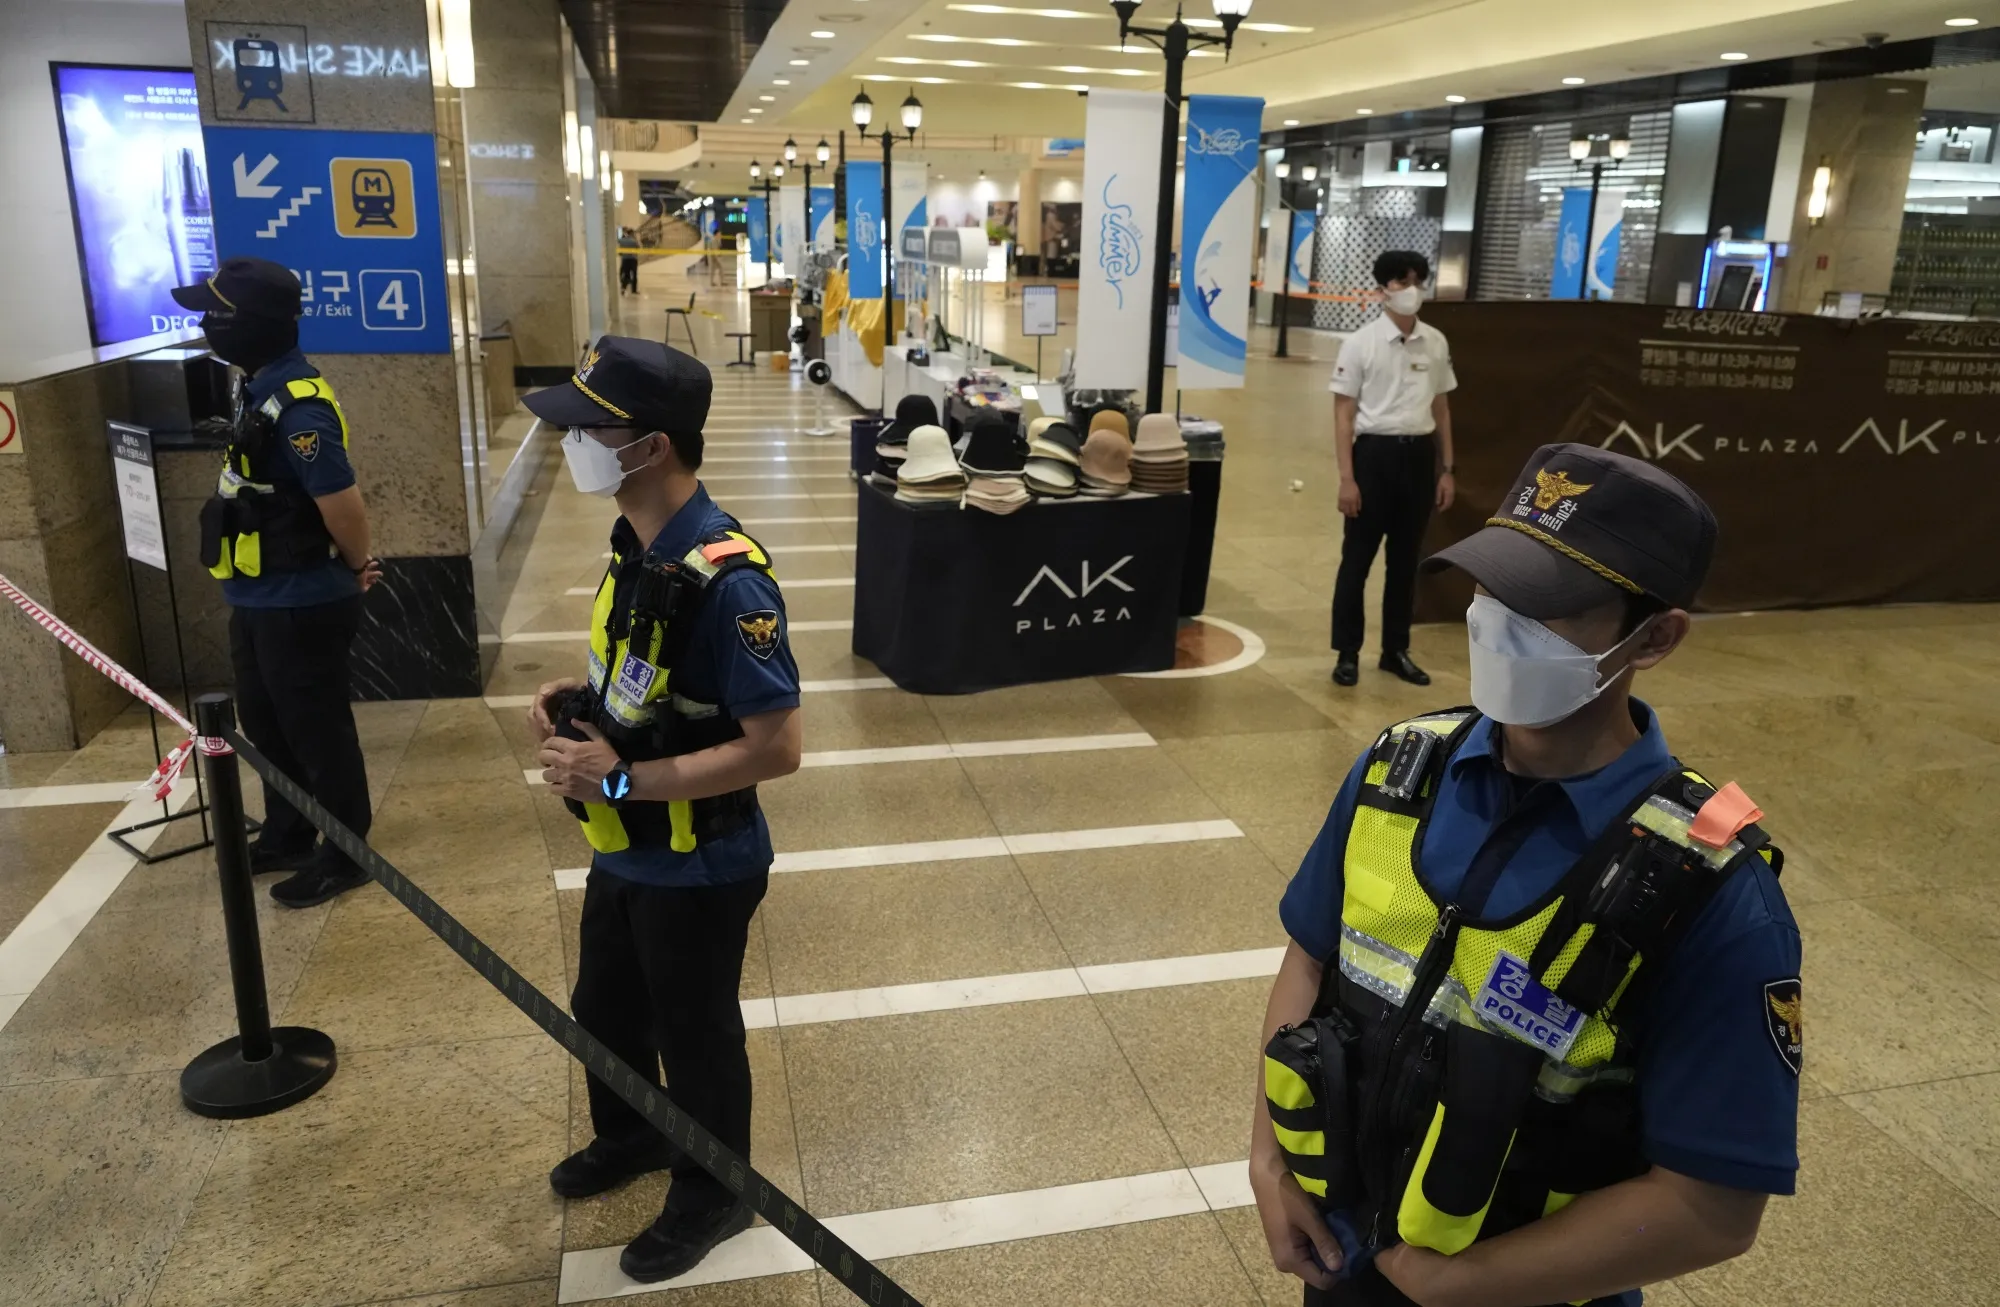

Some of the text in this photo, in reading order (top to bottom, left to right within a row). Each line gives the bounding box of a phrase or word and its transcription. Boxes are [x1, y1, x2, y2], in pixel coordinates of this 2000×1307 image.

[325, 304, 352, 317] Exit
[377, 280, 409, 320] 4
[1600, 420, 1818, 461] AK PLAZA
[1837, 417, 1947, 455] AK
[1012, 555, 1136, 607] AK
[1017, 607, 1132, 634] PLAZA
[619, 677, 645, 699] POLICE
[1484, 996, 1562, 1048] POLICE
